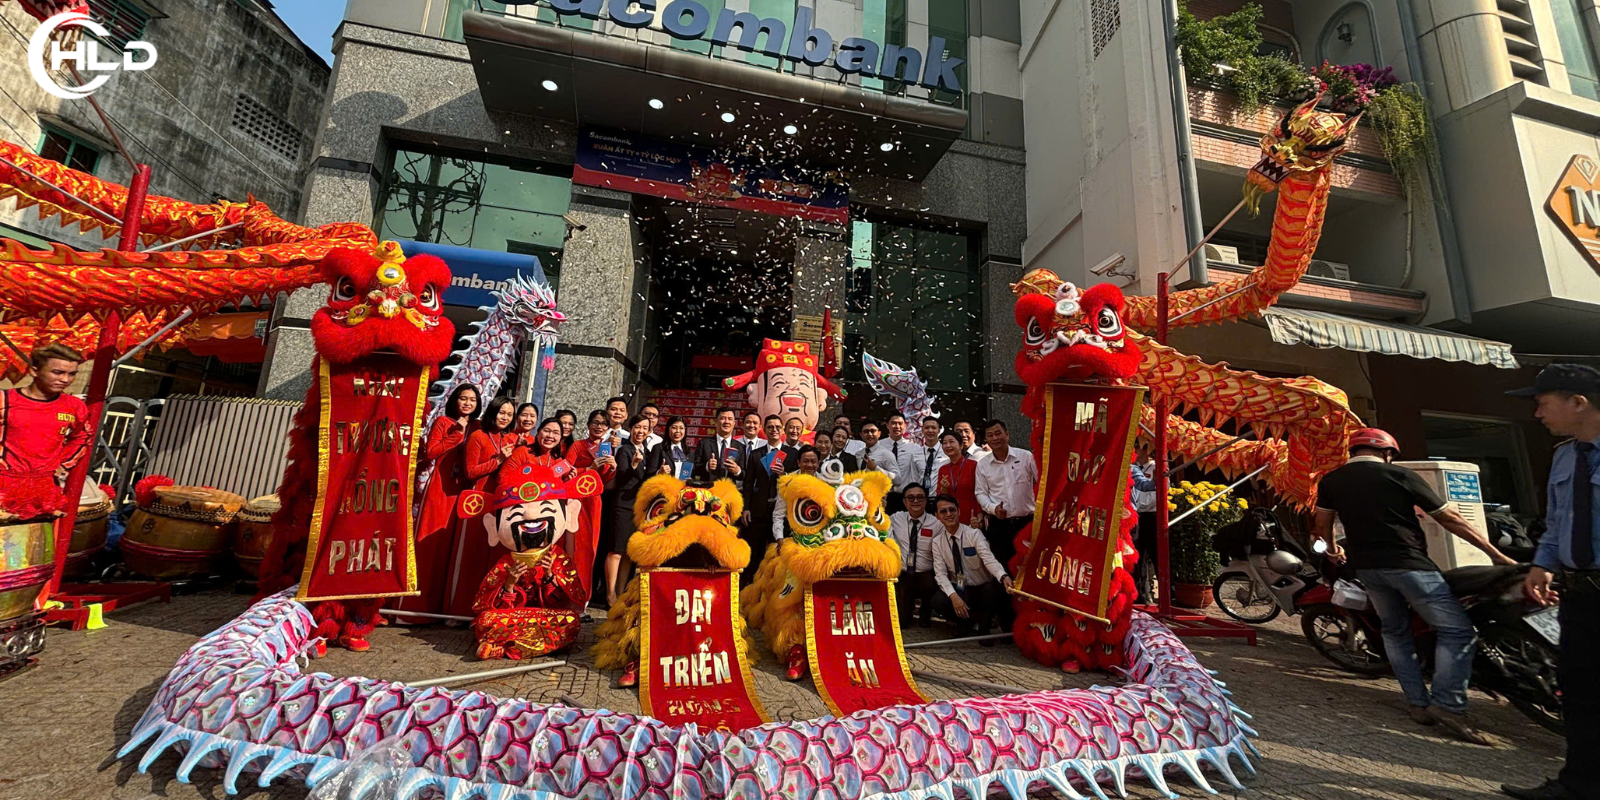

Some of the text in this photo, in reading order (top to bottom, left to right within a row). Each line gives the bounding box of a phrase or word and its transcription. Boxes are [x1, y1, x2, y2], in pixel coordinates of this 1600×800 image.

[589, 131, 631, 146] Sacombank
[1074, 398, 1110, 434] MÃ
[328, 530, 397, 575] PHÁT
[674, 588, 713, 632] ĐẠI
[829, 594, 876, 636] LÀM
[659, 636, 733, 688] TRIỂN
[844, 651, 881, 690] ĂN
